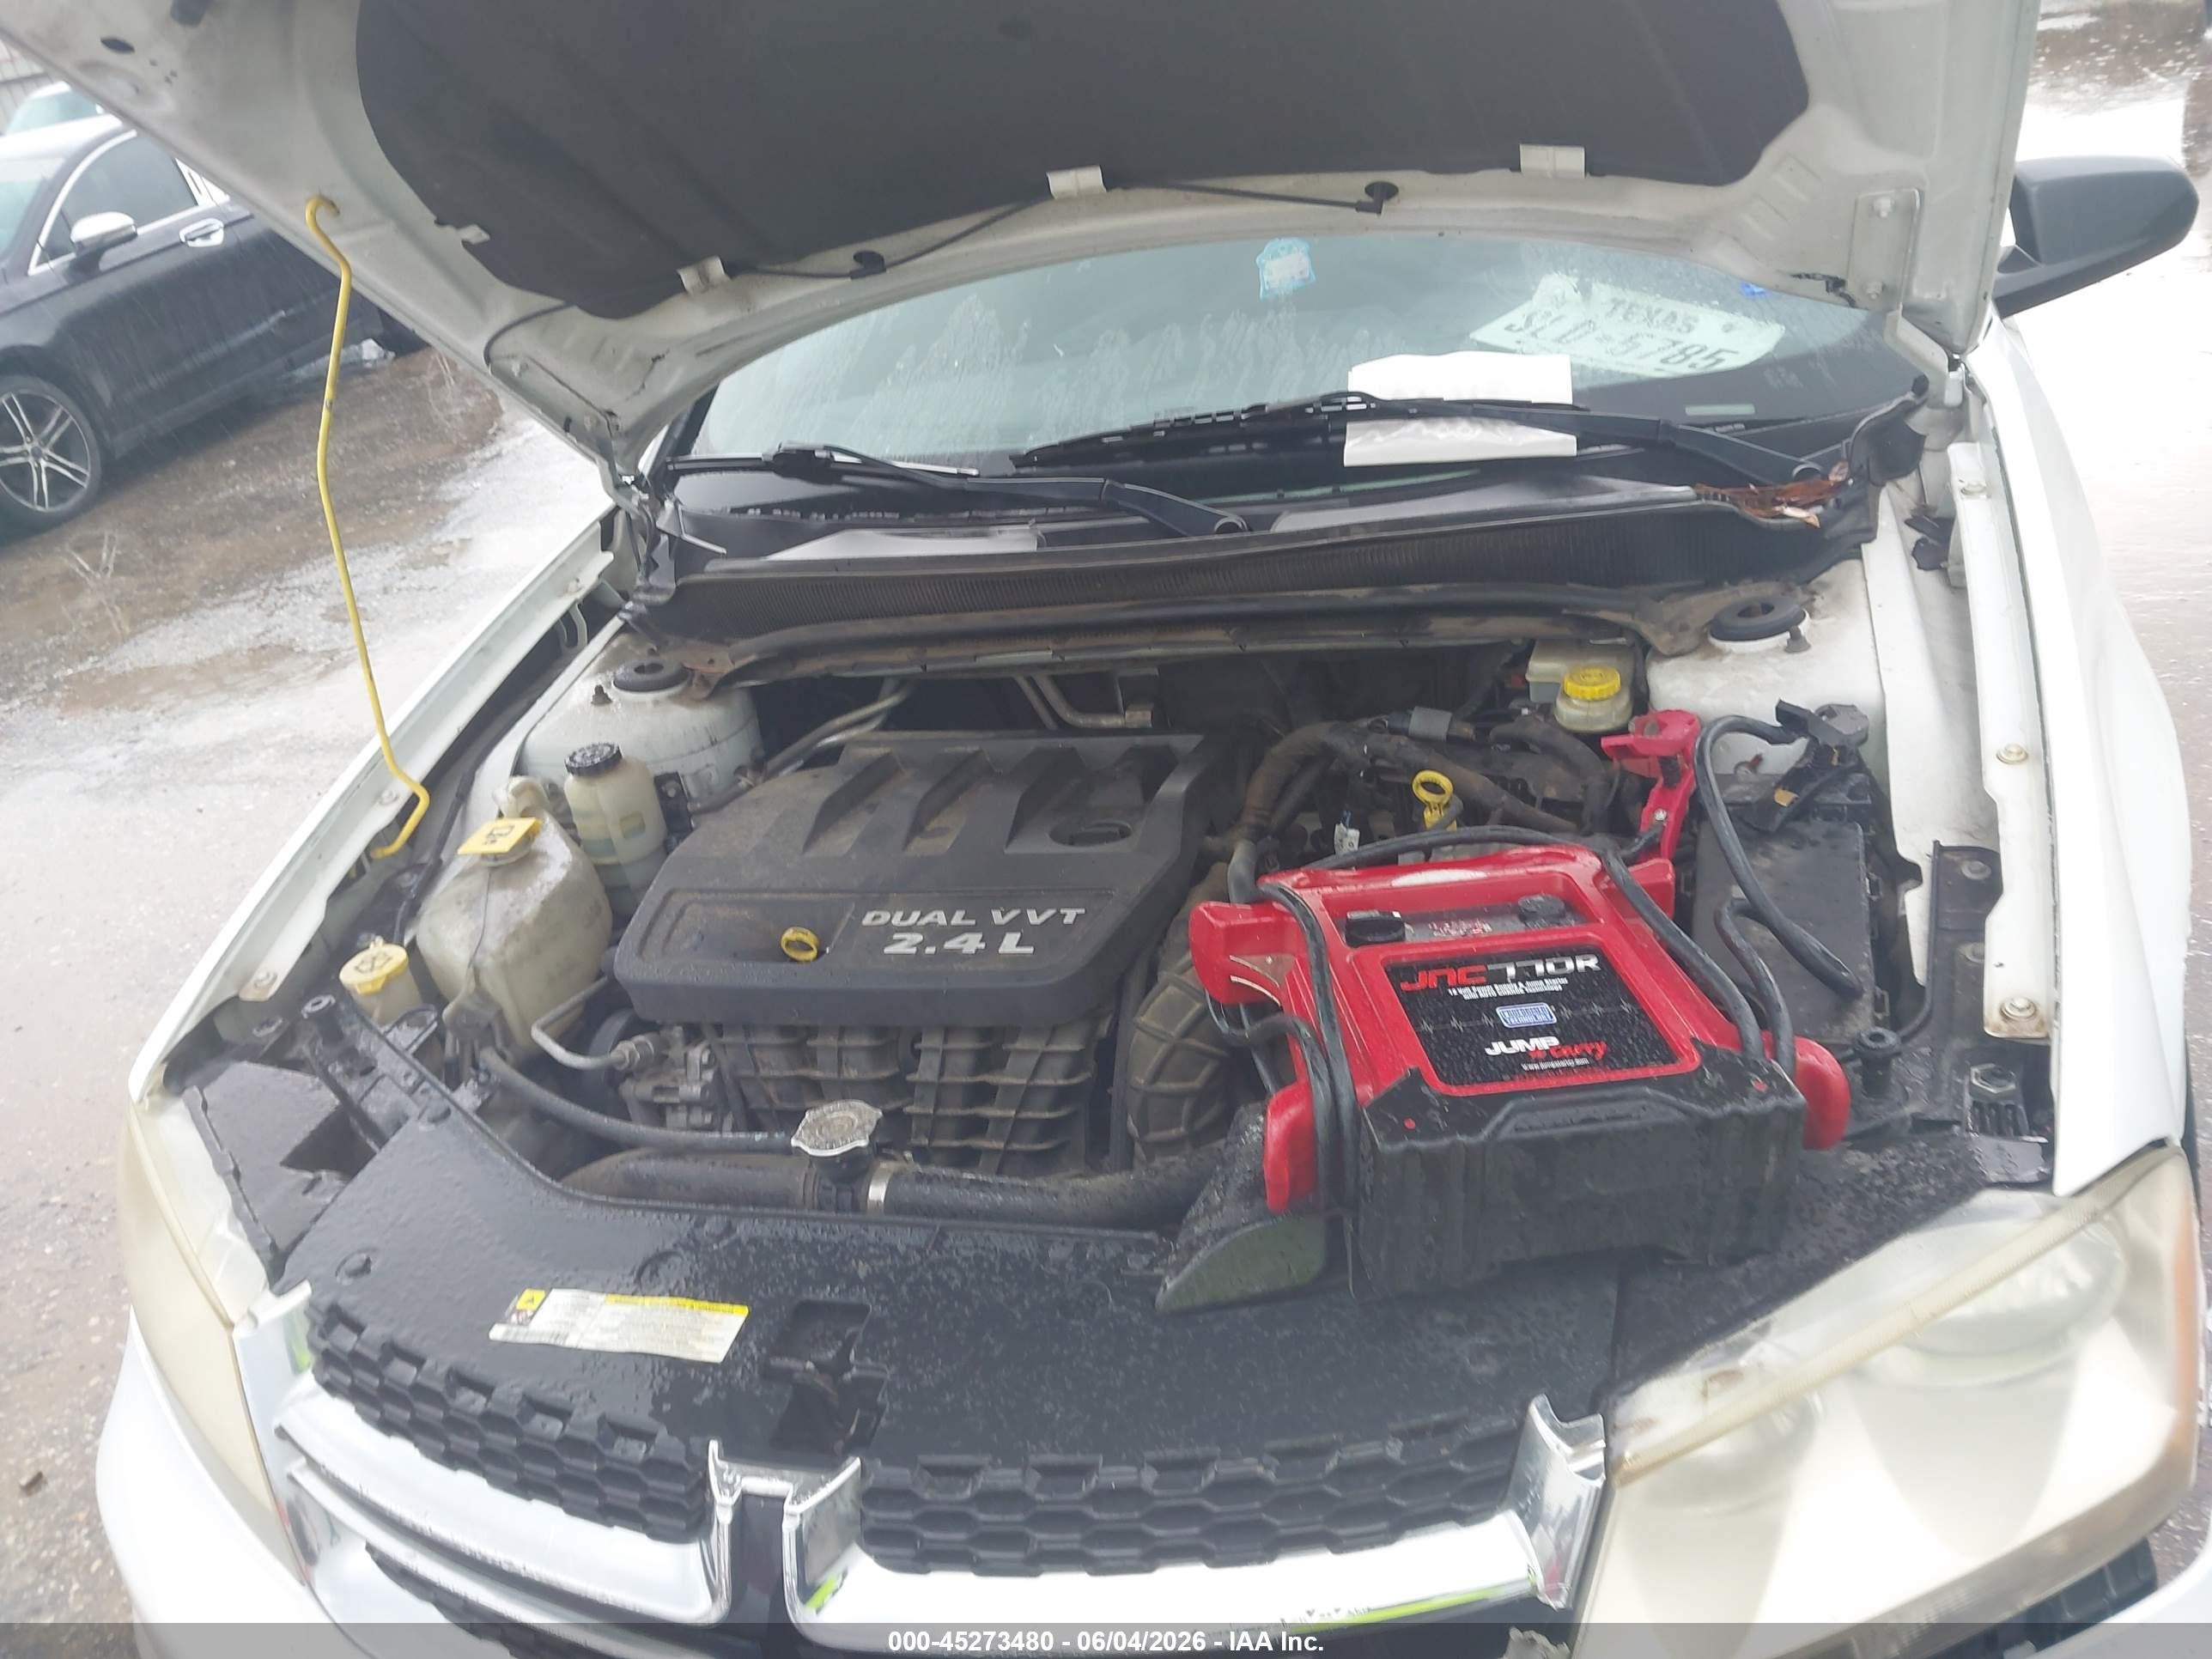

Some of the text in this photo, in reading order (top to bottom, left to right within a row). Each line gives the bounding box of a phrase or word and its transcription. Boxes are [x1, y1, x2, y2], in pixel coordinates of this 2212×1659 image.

[1604, 296, 1699, 334] TEXAS
[861, 908, 1086, 927] DUAL VVT
[1484, 1036, 1560, 1056] JUMP
